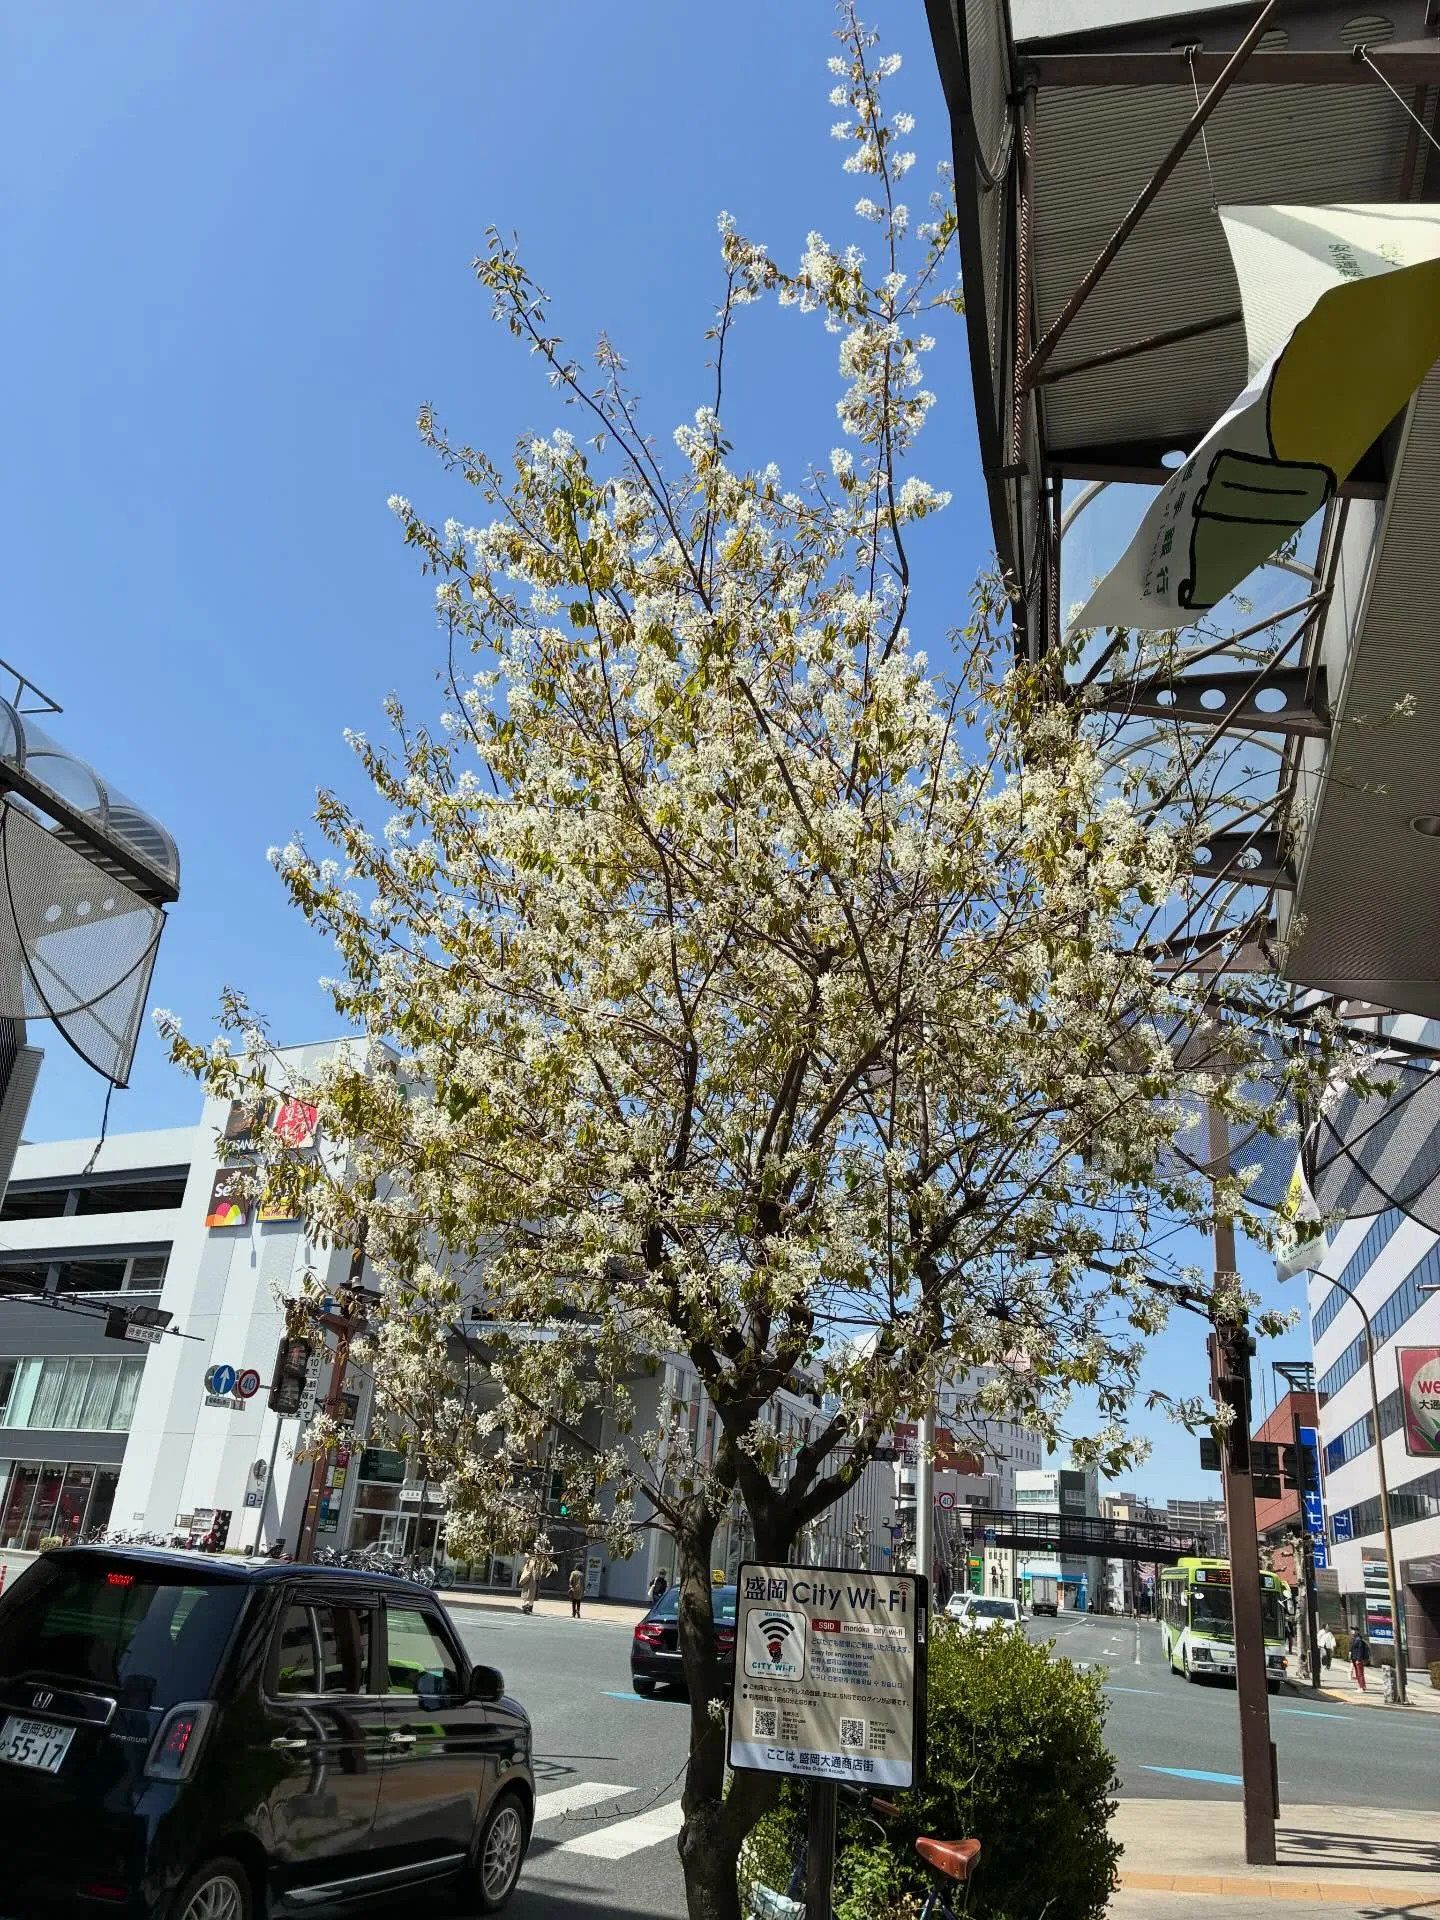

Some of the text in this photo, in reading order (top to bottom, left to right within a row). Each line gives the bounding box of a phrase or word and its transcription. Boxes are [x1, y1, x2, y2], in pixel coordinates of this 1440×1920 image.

[743, 1575, 787, 1602] 盛岡
[791, 1581, 841, 1611] City
[846, 1586, 906, 1612] Wi-Fi
[818, 1621, 834, 1629] SSID
[751, 1661, 771, 1670] CITY
[7, 1735, 64, 1767] 55-17
[767, 1748, 873, 1772] ここは 盛岡大通商店街
